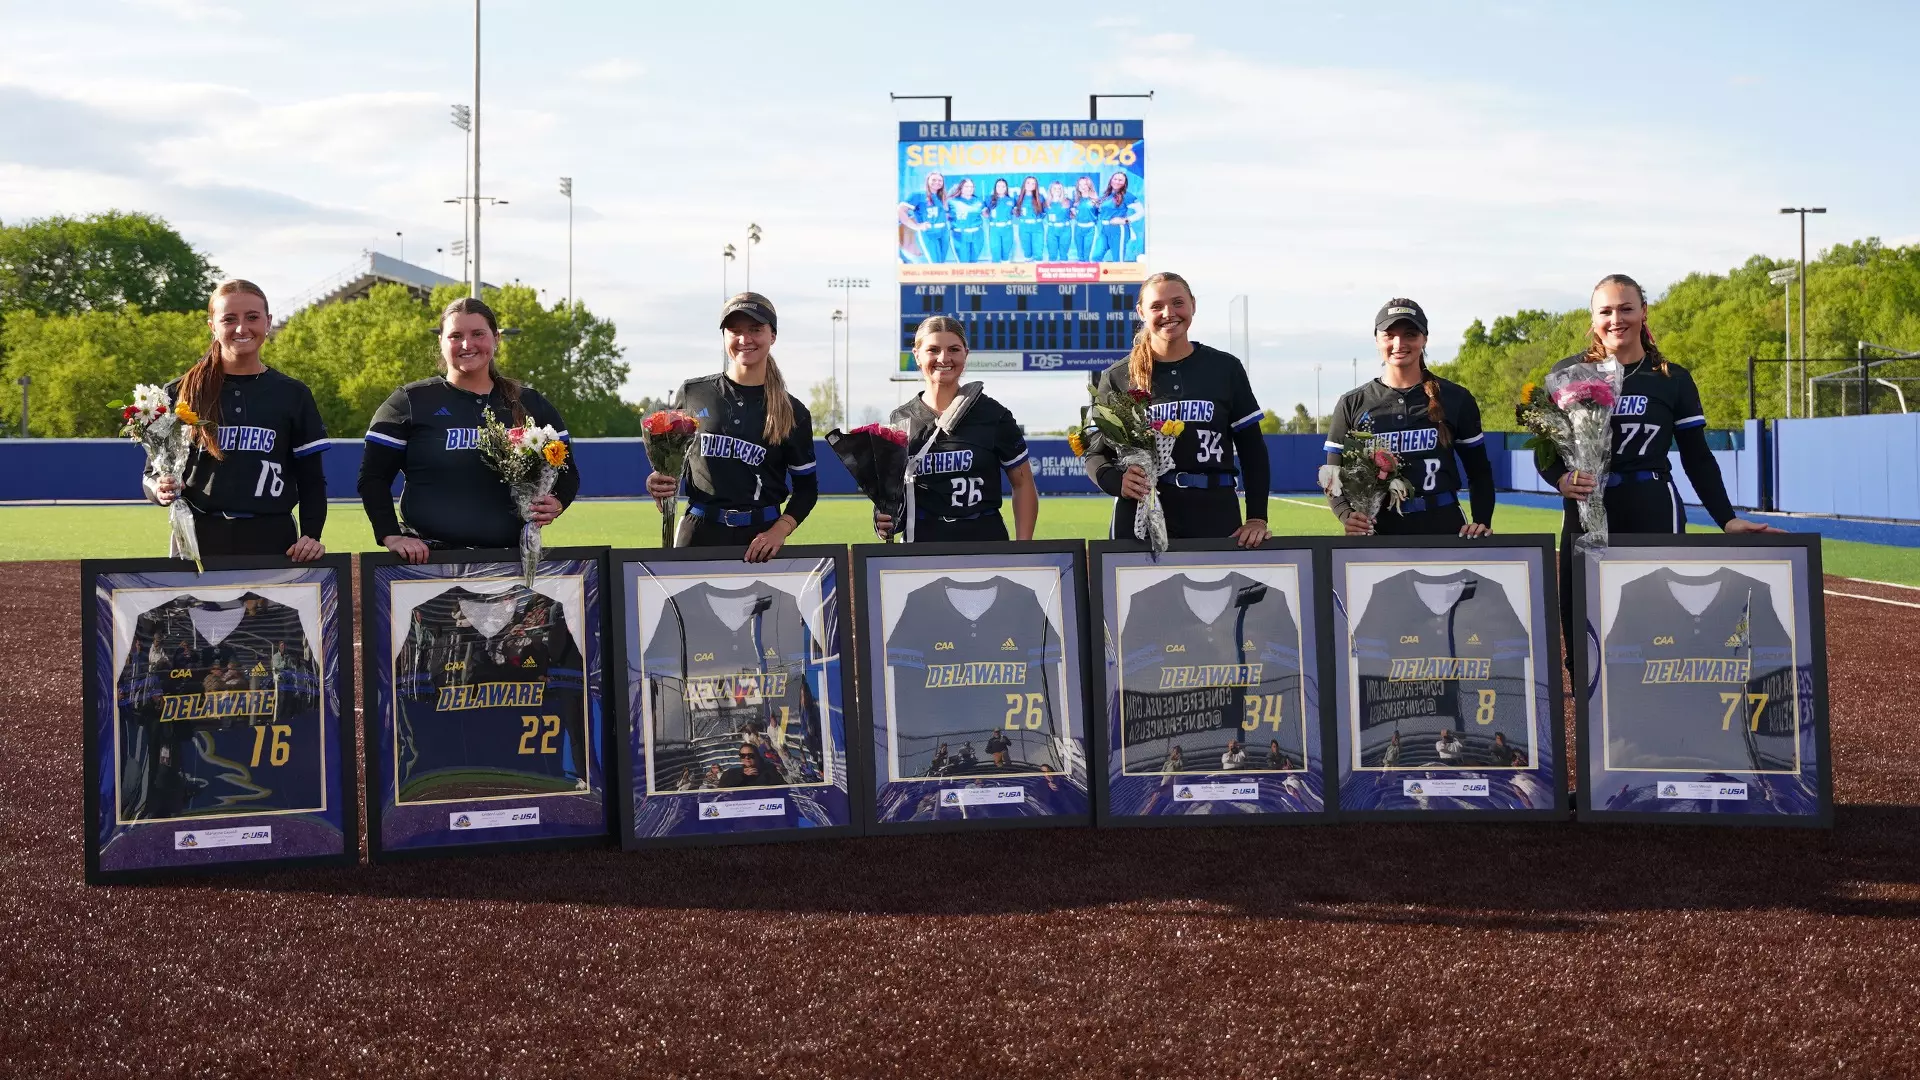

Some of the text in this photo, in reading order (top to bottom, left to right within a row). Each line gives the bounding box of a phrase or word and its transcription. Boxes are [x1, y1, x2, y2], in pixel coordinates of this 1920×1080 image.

[919, 122, 1125, 138] DELAWARE DIAMOND
[906, 143, 1136, 166] SENIOR DAY 2026
[915, 285, 946, 295] AT BAT
[964, 285, 988, 295] BALL
[1005, 285, 1038, 295] STRIKE
[1058, 284, 1077, 295] OUT
[1109, 284, 1125, 295] H/E
[959, 313, 965, 321] 2
[971, 313, 977, 321] 3
[986, 313, 992, 321] 4
[998, 313, 1004, 321] 5
[1010, 312, 1016, 321] 6
[1026, 312, 1031, 321] 7
[1037, 312, 1043, 321] 8
[1049, 312, 1055, 321] 9
[1063, 312, 1072, 320] 10
[1078, 312, 1100, 320] RUNS
[1106, 311, 1124, 320] HITS
[1179, 399, 1215, 423] HENS
[238, 425, 277, 453] HENS
[445, 428, 481, 451] BLU
[700, 433, 767, 467] BLUE HENS
[1196, 429, 1224, 463] 34
[1400, 427, 1439, 453] HENS
[1616, 422, 1661, 456] 77
[934, 449, 974, 474] HENS
[1042, 456, 1087, 468] DELAWAR
[1042, 467, 1066, 477] STATE
[254, 459, 285, 497] 16
[1422, 458, 1441, 491] 8
[950, 477, 985, 507] 26
[934, 642, 955, 651] CAA
[1165, 644, 1186, 653] CAA
[1400, 635, 1420, 644] CAA
[1653, 636, 1675, 645] CAA
[445, 661, 467, 671] CAA
[694, 652, 714, 662] CAA
[1388, 657, 1492, 682] DELAWARE
[170, 668, 192, 679] CAA
[925, 661, 1027, 688] DELAWARE
[1159, 663, 1263, 690] DELAWARE
[1642, 658, 1751, 684] DELAWARE
[160, 689, 277, 722] DELAWARE
[436, 682, 545, 712] DELAWARE
[1475, 689, 1497, 725] 8
[1005, 692, 1044, 731] 26
[1241, 694, 1283, 732] 34
[1719, 692, 1769, 732] 77
[250, 725, 292, 767] 16
[518, 715, 560, 755] 22
